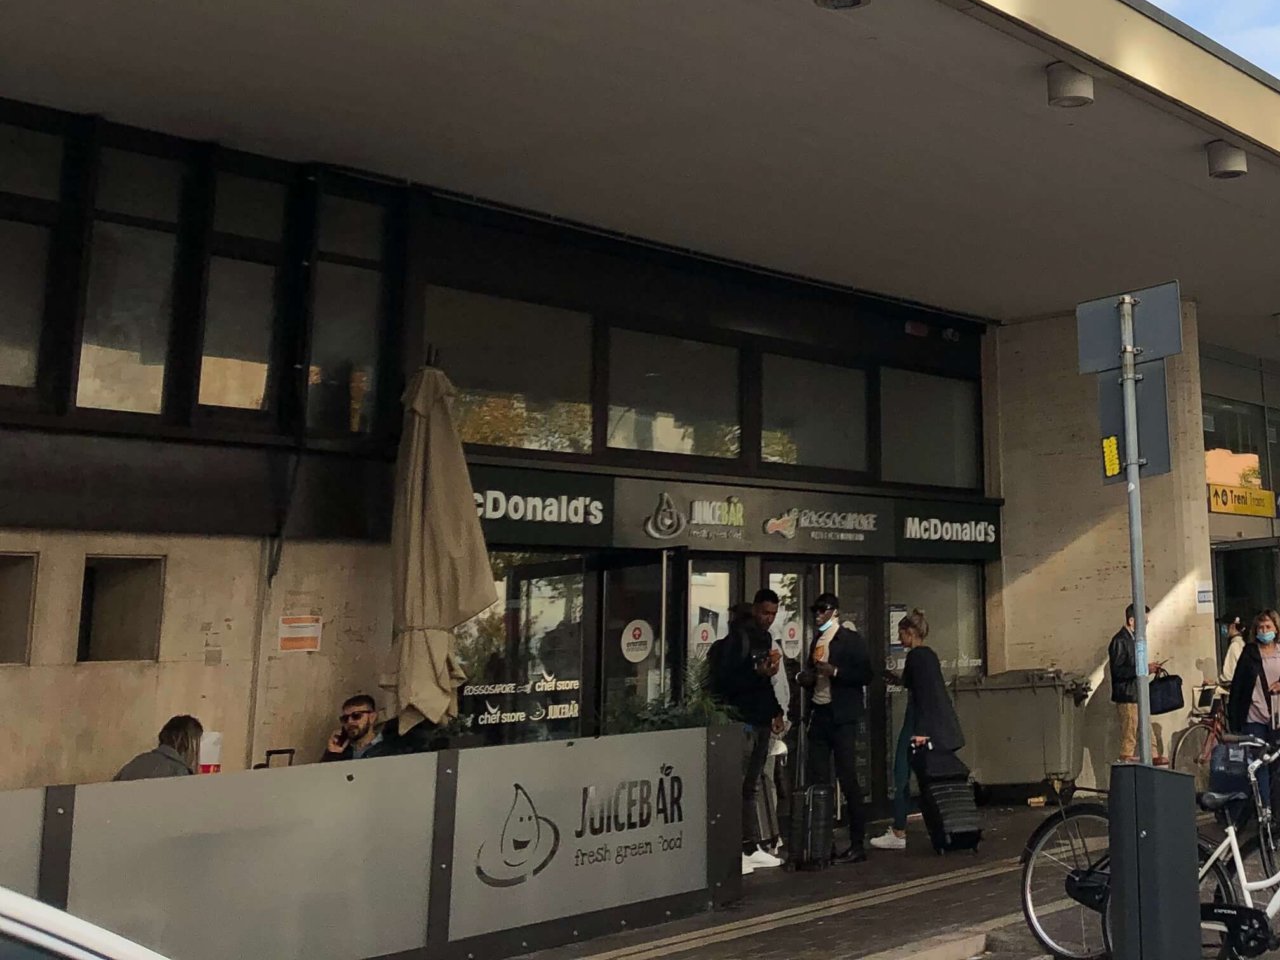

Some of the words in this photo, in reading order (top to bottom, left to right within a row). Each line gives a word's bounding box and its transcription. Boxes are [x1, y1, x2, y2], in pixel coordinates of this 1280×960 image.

[473, 491, 603, 525] cDonald's
[904, 517, 995, 543] McDonald's
[463, 683, 516, 696] ROSSOSAPORE
[478, 711, 501, 725] chef
[574, 843, 611, 867] fresh
[614, 841, 653, 865] green
